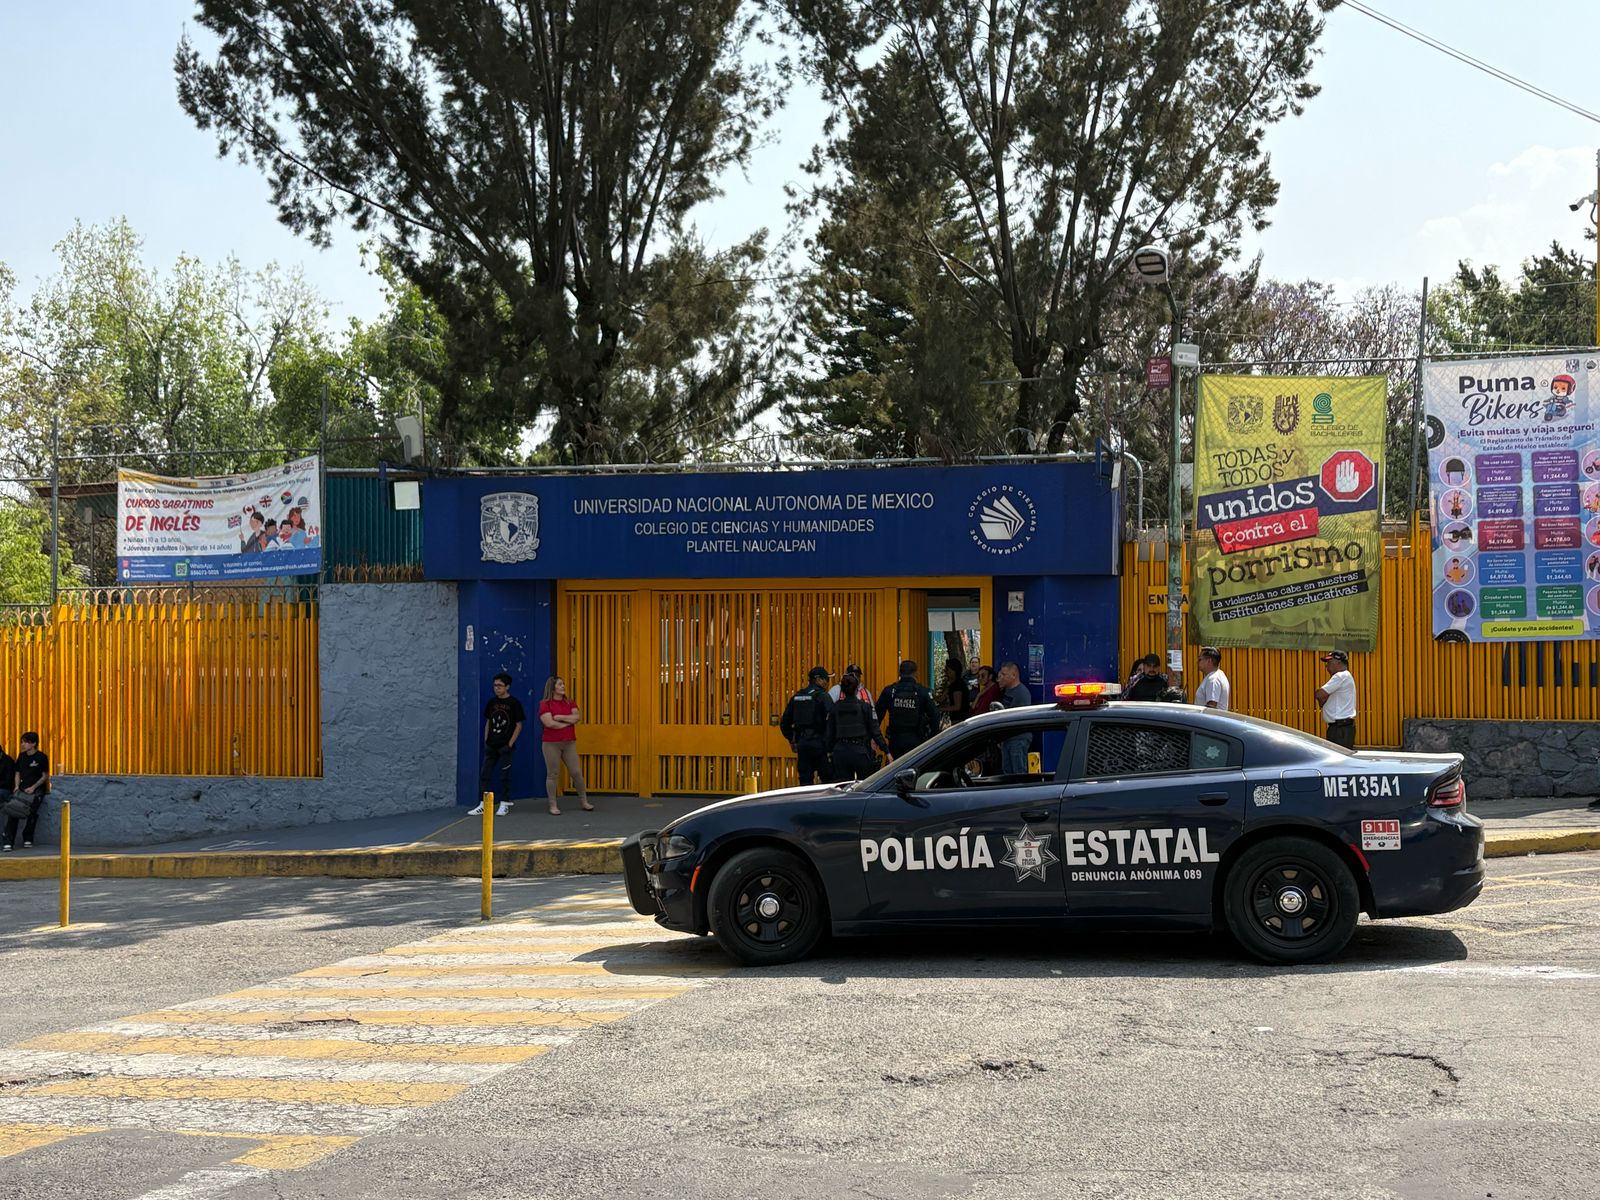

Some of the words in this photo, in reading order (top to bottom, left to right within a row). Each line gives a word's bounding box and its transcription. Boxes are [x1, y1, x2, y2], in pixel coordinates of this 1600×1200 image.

[1458, 375, 1536, 394] Puma
[1462, 392, 1544, 426] Bikers
[1457, 429, 1485, 439] ¡Evita
[1486, 427, 1521, 436] multas
[1523, 428, 1530, 436] y
[1531, 425, 1555, 435] viaja
[1556, 423, 1595, 434] seguro!
[1212, 443, 1278, 471] TODAS
[1282, 448, 1296, 464] y
[1218, 461, 1285, 489] TODOS
[125, 498, 161, 510] CURSOS
[162, 499, 214, 510] SABATINOS
[573, 498, 673, 515] UNIVERSIDAD
[677, 496, 752, 513] NACIONAL
[755, 495, 843, 511] AUTONOMA
[846, 494, 867, 511] DE
[871, 492, 935, 510] MEXICO
[968, 485, 998, 518] COLEGIO
[1002, 485, 1014, 493] DE
[1017, 489, 1037, 533] CIENCIAS
[1204, 480, 1316, 522] unidos
[124, 515, 147, 532] DE
[149, 509, 202, 532] INGLÉS
[634, 521, 689, 535] COLEGIO
[691, 521, 709, 534] DE
[711, 520, 769, 534] CIENCIAS
[772, 520, 780, 533] Y
[783, 519, 875, 533] HUMANIDADES
[1221, 521, 1286, 546] contra
[1290, 513, 1309, 533] el
[686, 540, 741, 553] PLANTEL
[742, 539, 817, 553] NAUCALPAN
[1206, 541, 1364, 597] porrismo
[1148, 593, 1189, 605] ENA
[1211, 600, 1224, 610] La
[1224, 591, 1265, 607] violencia
[1266, 589, 1279, 598] no
[1280, 584, 1302, 596] cabe
[1303, 582, 1316, 592] en
[1316, 571, 1360, 590] nuestras
[1218, 597, 1295, 622] instituciones
[1296, 584, 1359, 607] educativas
[1323, 775, 1402, 799] ME135A1
[860, 826, 995, 872] POLICÍA
[1065, 827, 1221, 867] ESTATAL
[1362, 835, 1401, 843] EMERGENCIAS
[1071, 870, 1127, 881] DENUNCIA
[1129, 868, 1182, 881] ANÓNIMA
[1183, 869, 1203, 880] 089
